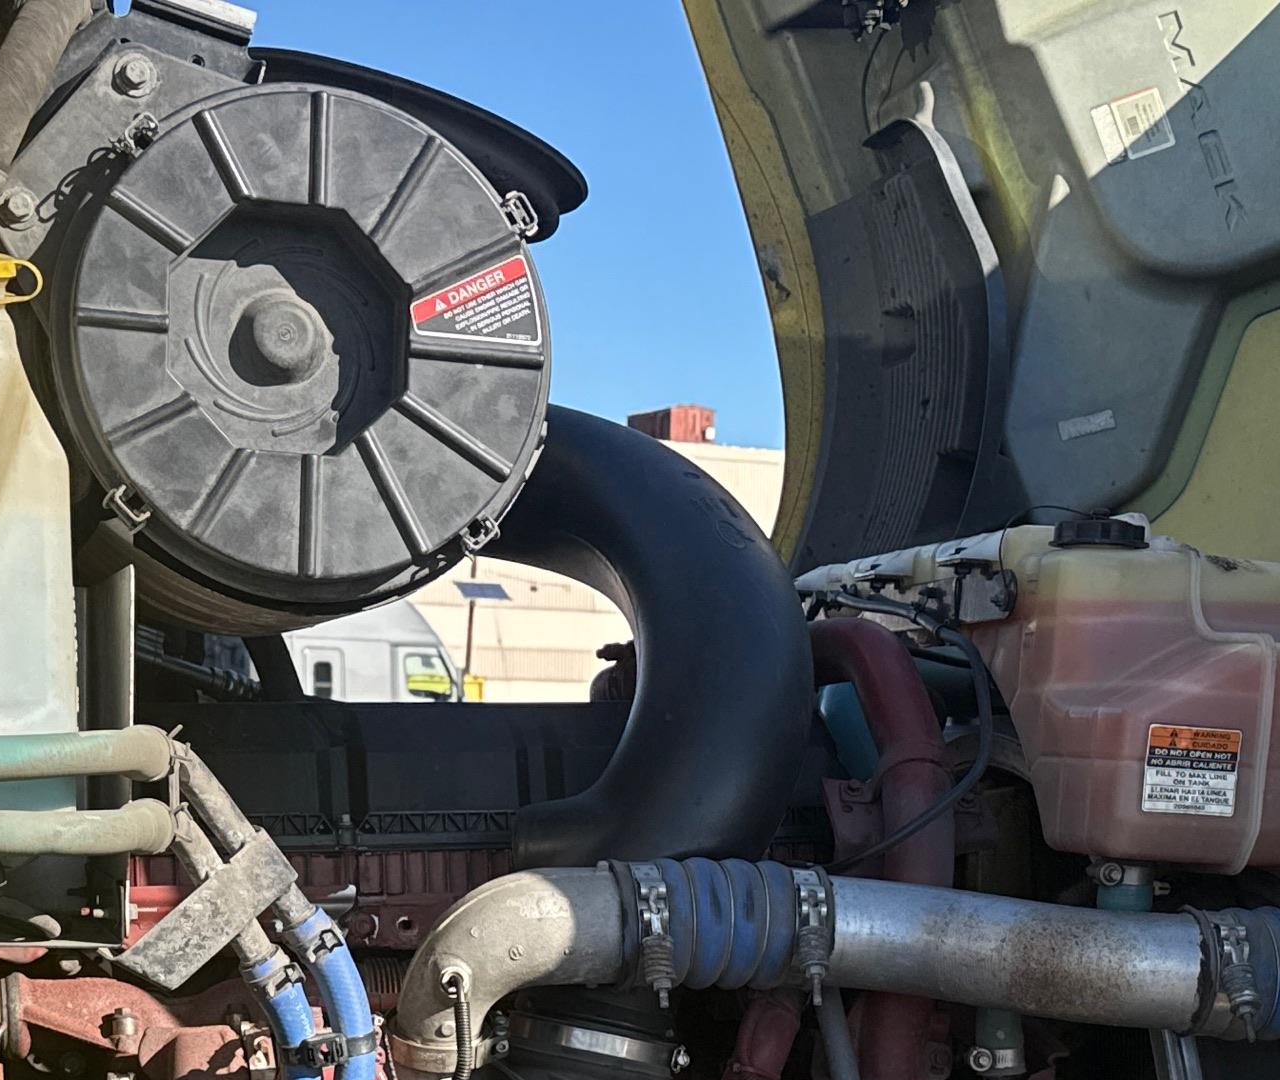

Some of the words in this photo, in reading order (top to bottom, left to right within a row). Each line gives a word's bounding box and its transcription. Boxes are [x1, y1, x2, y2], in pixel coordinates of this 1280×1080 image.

[448, 270, 506, 304] DANGER
[453, 305, 465, 315] NOT
[1193, 731, 1232, 740] WARNING
[1192, 741, 1228, 749] CUIDADO
[1193, 762, 1232, 770] CALIENTE
[1202, 796, 1229, 804] TANQUE
